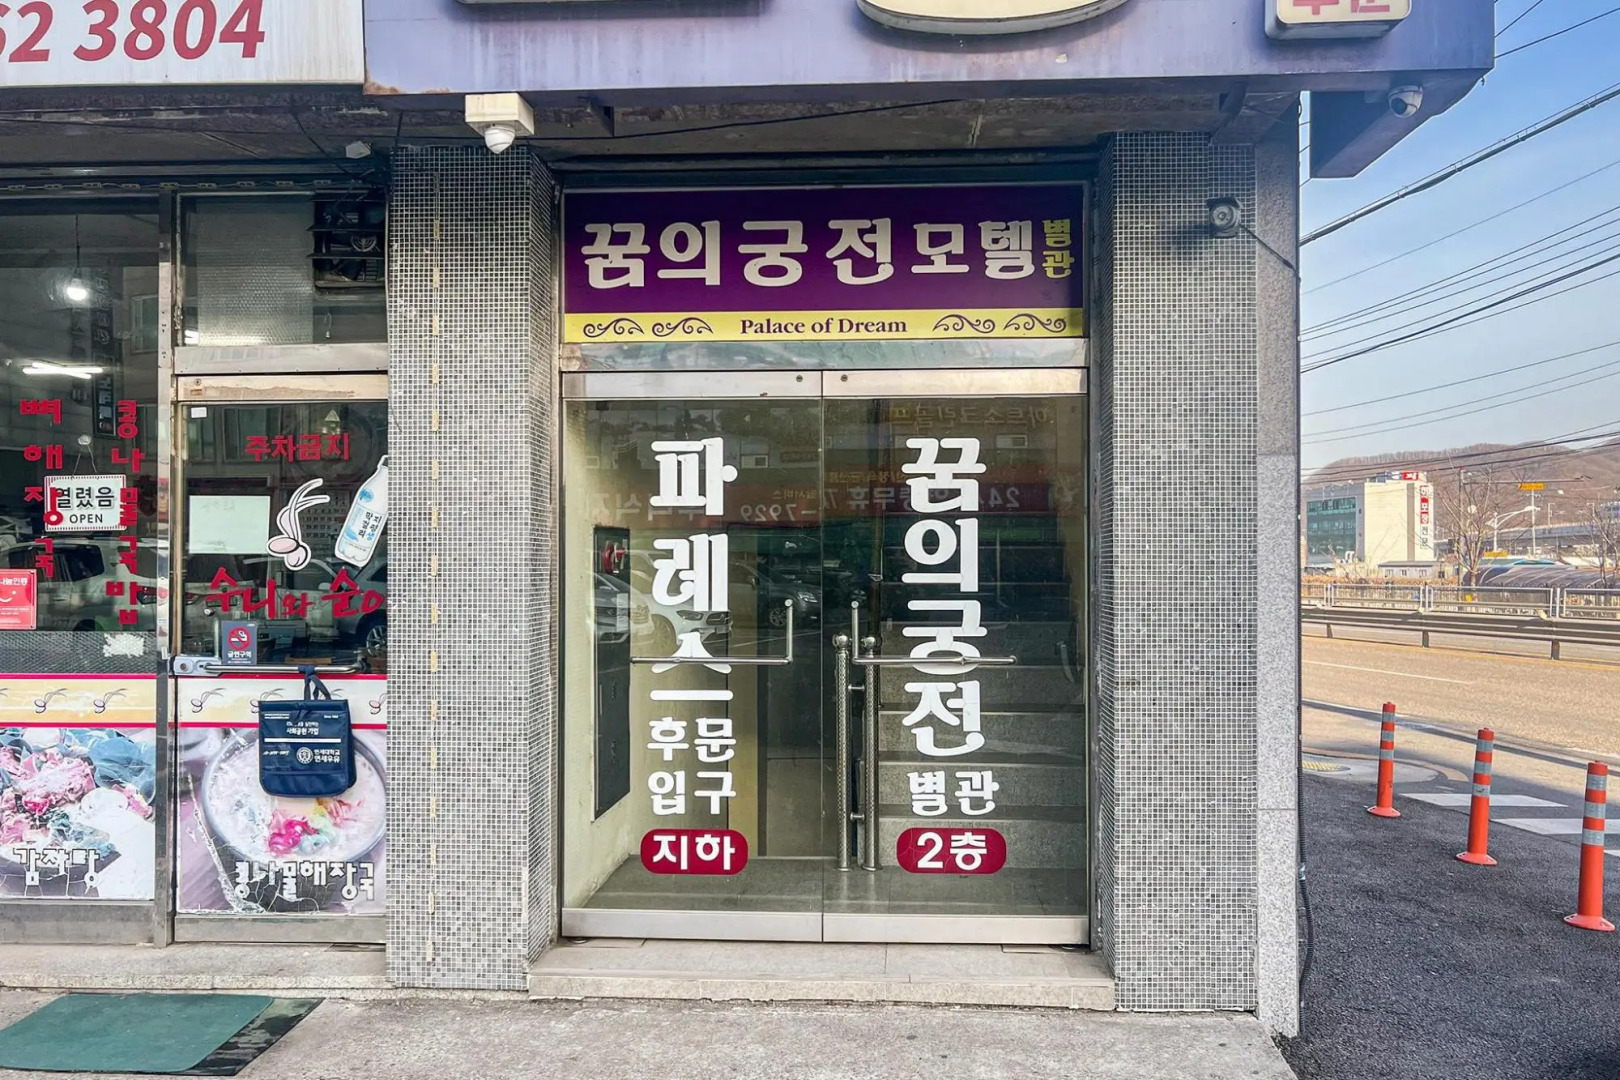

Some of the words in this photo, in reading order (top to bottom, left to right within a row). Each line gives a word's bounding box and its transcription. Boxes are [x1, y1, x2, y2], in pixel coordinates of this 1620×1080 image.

[0, 1, 53, 62] 2
[73, 0, 264, 62] 3804
[1042, 218, 1075, 279] 별관
[740, 318, 805, 334] Palace
[811, 318, 833, 333] of
[838, 318, 907, 333] Dream
[244, 432, 350, 462] 주차금지
[55, 486, 115, 509] 열렸음
[69, 513, 103, 524] OPEN
[105, 400, 146, 625] 콩나물국밥
[650, 437, 738, 701] 파레스
[901, 437, 988, 756] 꿈의궁전
[314, 755, 341, 764] 연세우유
[647, 716, 737, 762] 후문
[647, 770, 737, 816] 입구
[906, 770, 1000, 816] 별관
[652, 833, 736, 871] 지하
[916, 832, 988, 871] 2층
[234, 860, 375, 901] 콩나물해장국
